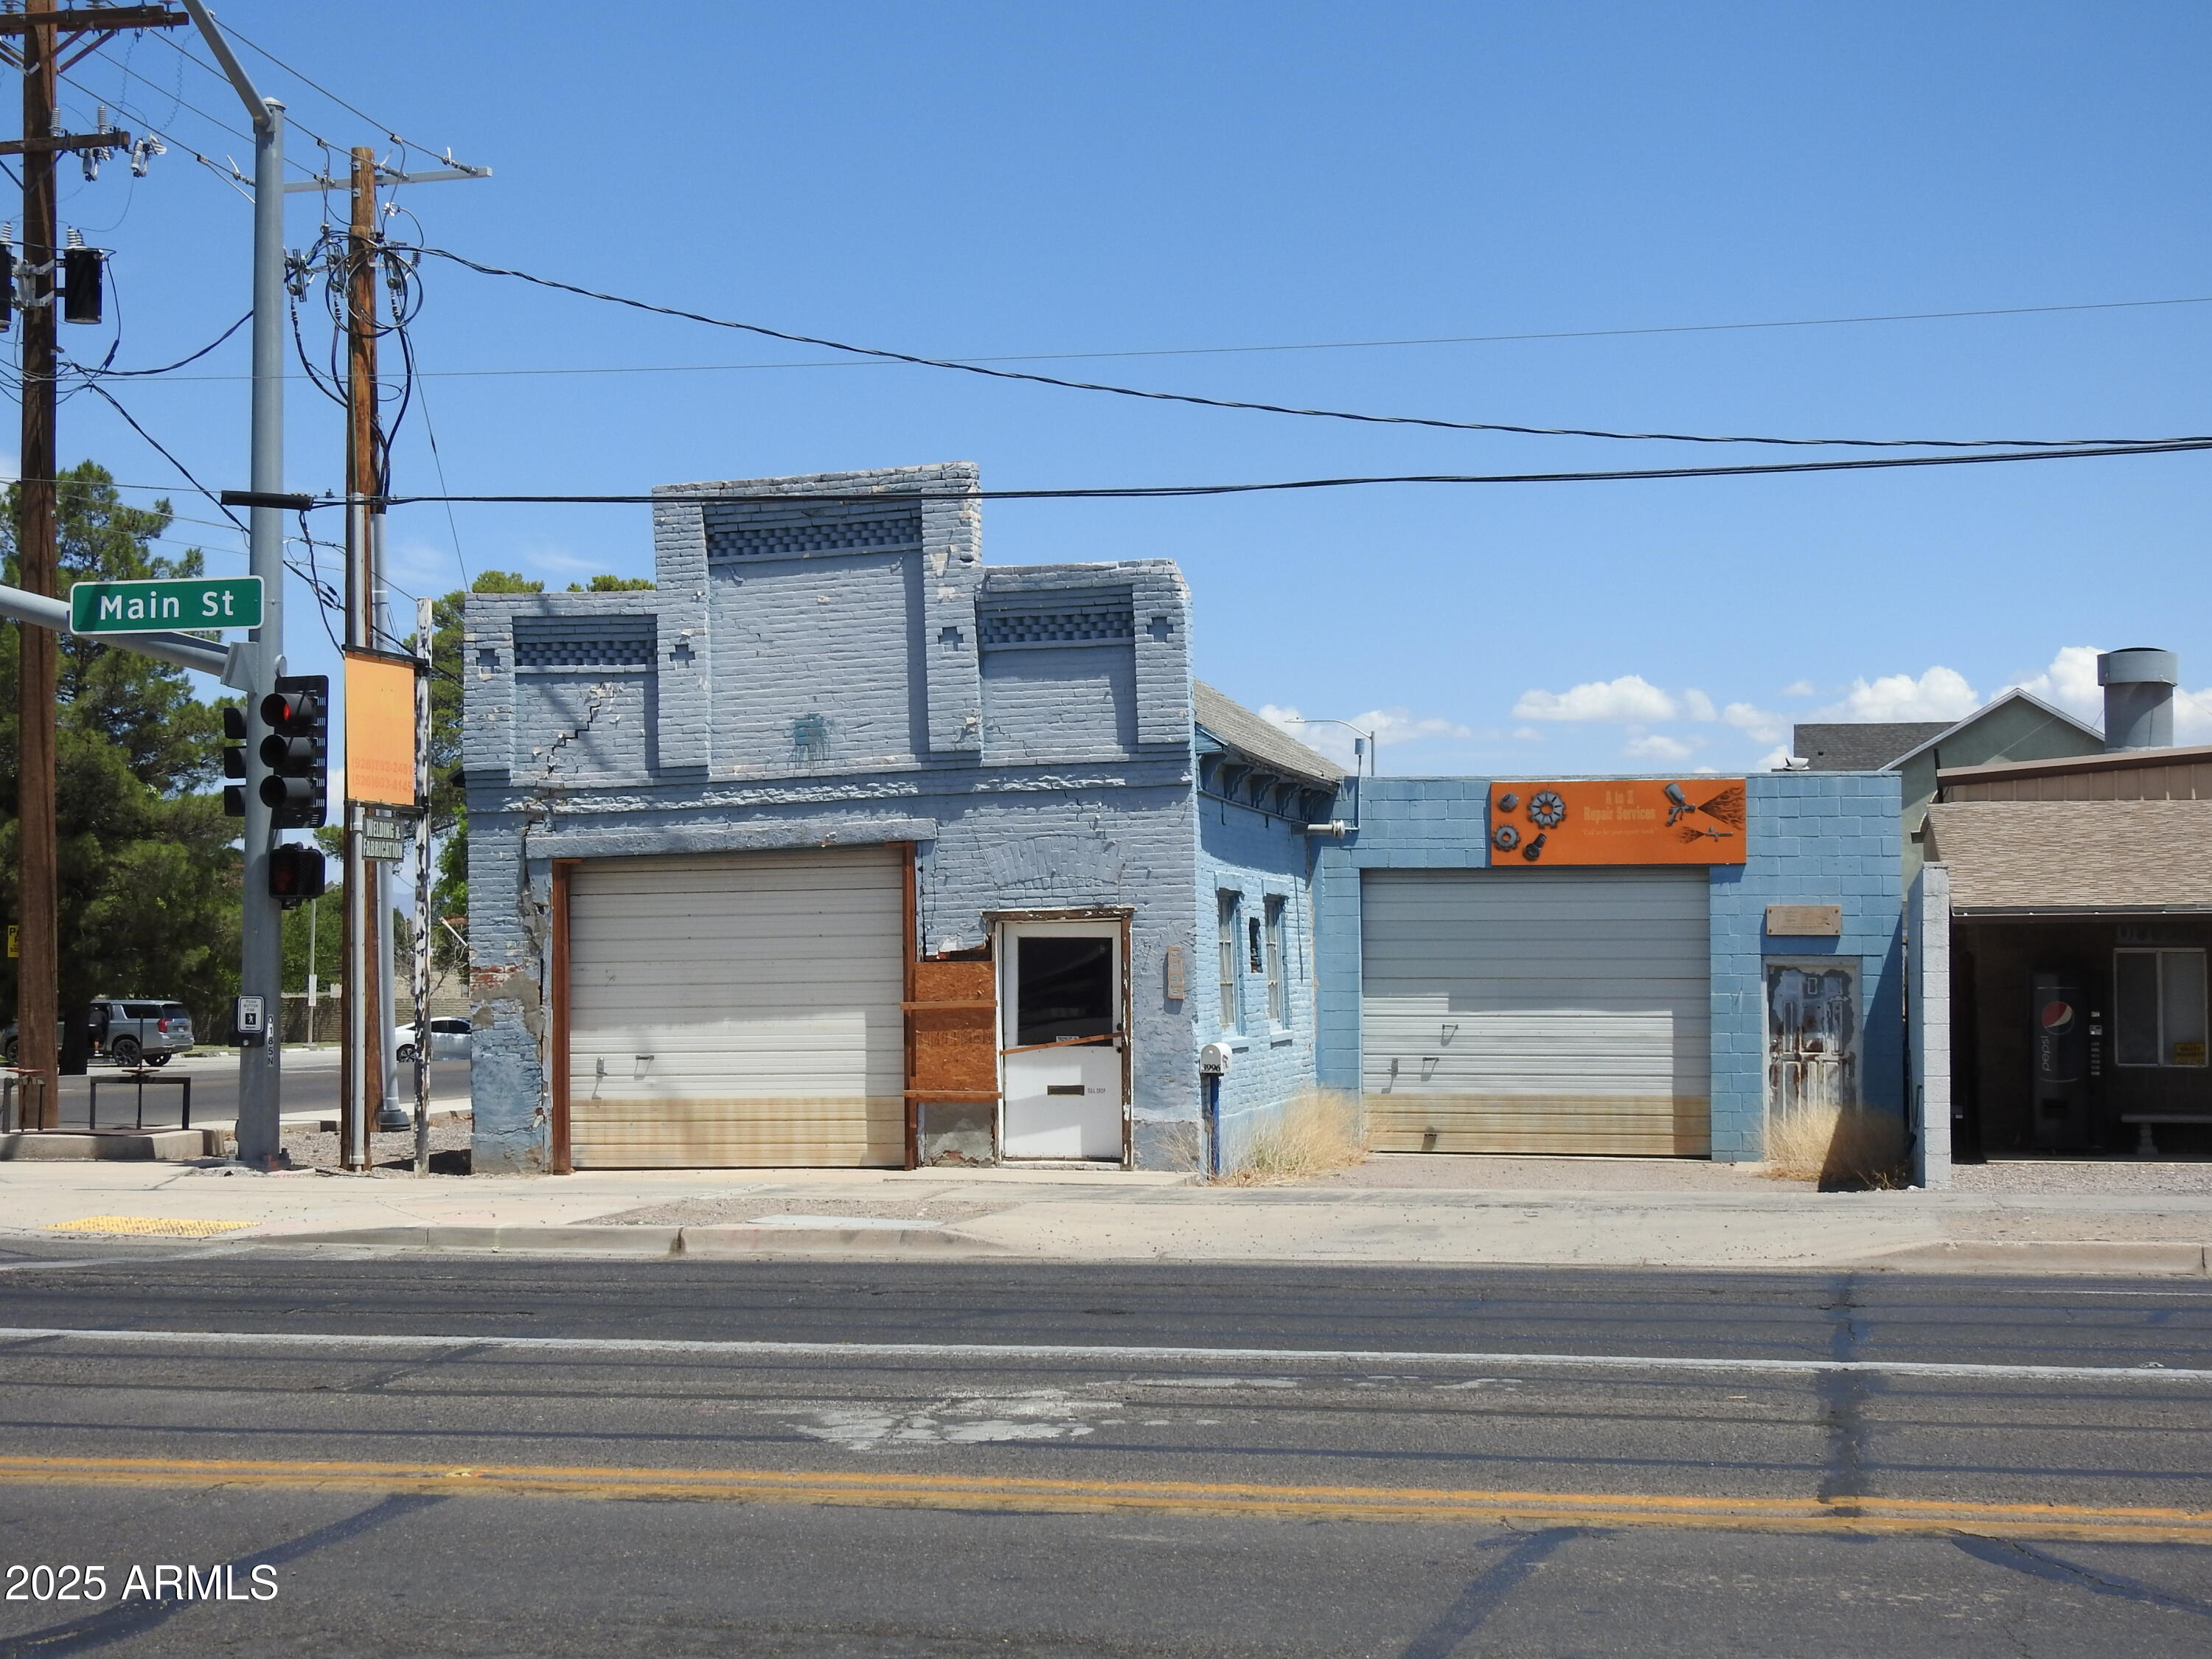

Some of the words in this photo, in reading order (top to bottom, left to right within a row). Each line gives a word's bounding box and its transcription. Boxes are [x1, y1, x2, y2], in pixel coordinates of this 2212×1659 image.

[100, 591, 179, 620] Main
[202, 591, 234, 616] St
[1584, 806, 1613, 824] Repair
[1616, 805, 1655, 821] Services
[366, 818, 394, 838] WELDING
[396, 826, 400, 839] &
[364, 838, 403, 859] FABRICATION
[2040, 1035, 2052, 1071] pepsi
[1203, 1063, 1221, 1071] 3996
